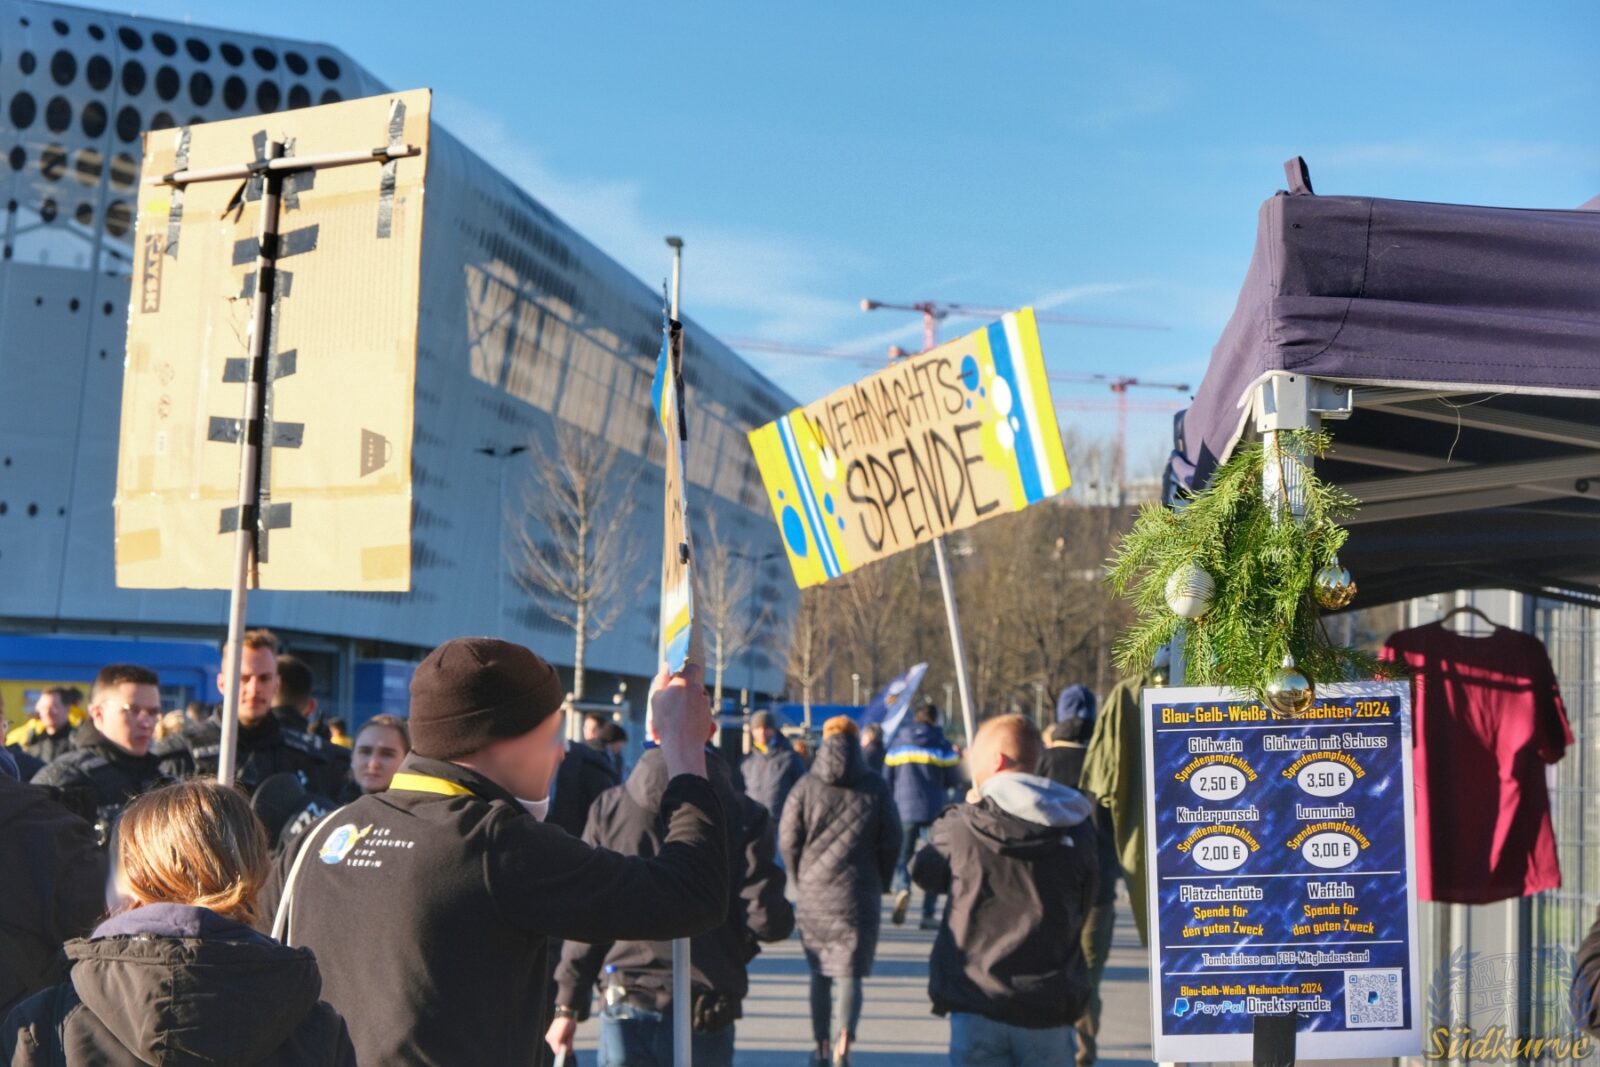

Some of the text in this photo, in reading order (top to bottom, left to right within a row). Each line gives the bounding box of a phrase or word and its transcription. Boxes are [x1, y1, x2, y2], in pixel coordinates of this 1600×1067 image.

[802, 359, 973, 461] WEIHNACHTS-
[846, 420, 1000, 551] SPENDE
[1162, 705, 1267, 724] Blau-Gelb-Weiße
[1355, 701, 1390, 718] 2024
[1189, 737, 1243, 753] Glühwein
[1263, 733, 1388, 751] Glühwein mit Schuss
[1175, 753, 1258, 783] Spendenempfehlung
[1281, 750, 1366, 780] Spendenempfehlung
[1199, 776, 1238, 792] 2,50 €
[1307, 772, 1346, 788] 3,50 €
[1177, 805, 1259, 824] Kinderpunsch
[1296, 802, 1355, 819] Lumumba
[1176, 823, 1261, 853] Spendenempfehlung
[1286, 820, 1371, 850] Spendenempfehlung
[1202, 846, 1241, 861] 2,00 €
[1311, 843, 1351, 858] 3,00 €
[1180, 885, 1263, 902] Plätzchentüte
[1307, 882, 1354, 899] Waffeln
[1193, 905, 1248, 920] Spende für
[1303, 903, 1359, 918] Spende für
[1182, 921, 1264, 938] den guten Zweck
[1292, 919, 1375, 936] den guten Zweck
[1202, 950, 1370, 966] Tombolalose am FCC-Mitgliederstand
[1180, 983, 1322, 996] Blau-Gelb-Weiße Weihnachten 2024
[1194, 995, 1332, 1016] PayPal Direktspende:
